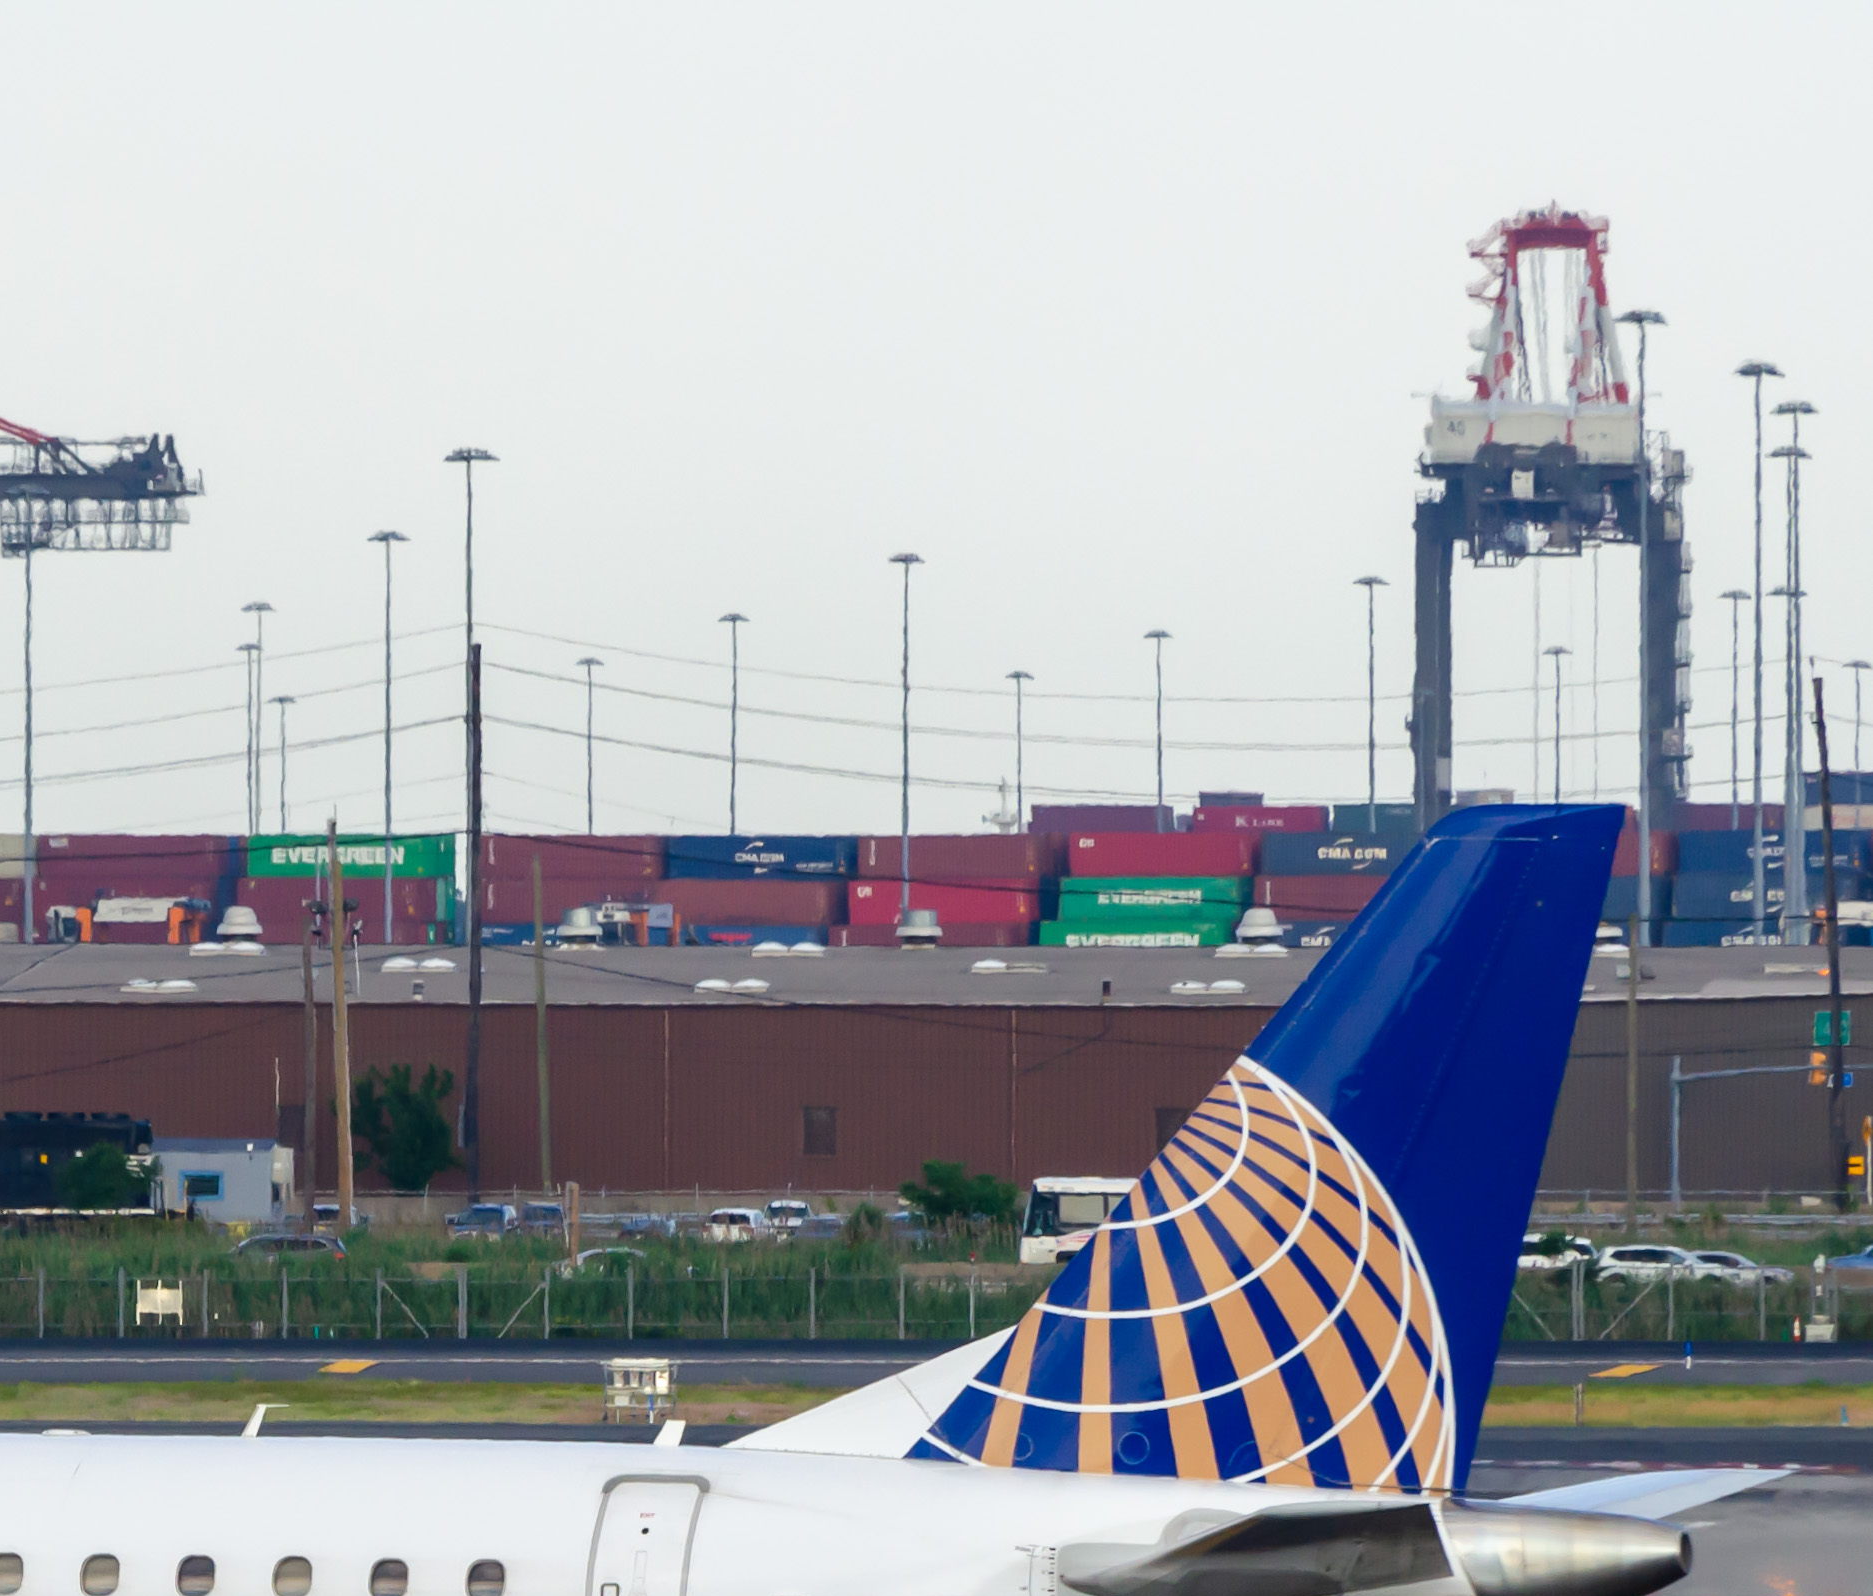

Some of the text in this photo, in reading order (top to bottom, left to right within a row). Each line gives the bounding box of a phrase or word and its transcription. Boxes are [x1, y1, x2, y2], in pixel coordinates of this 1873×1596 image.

[271, 846, 404, 865] EVERGREEN
[1317, 847, 1351, 859] CMA
[1065, 933, 1200, 948] EVERGREEN
